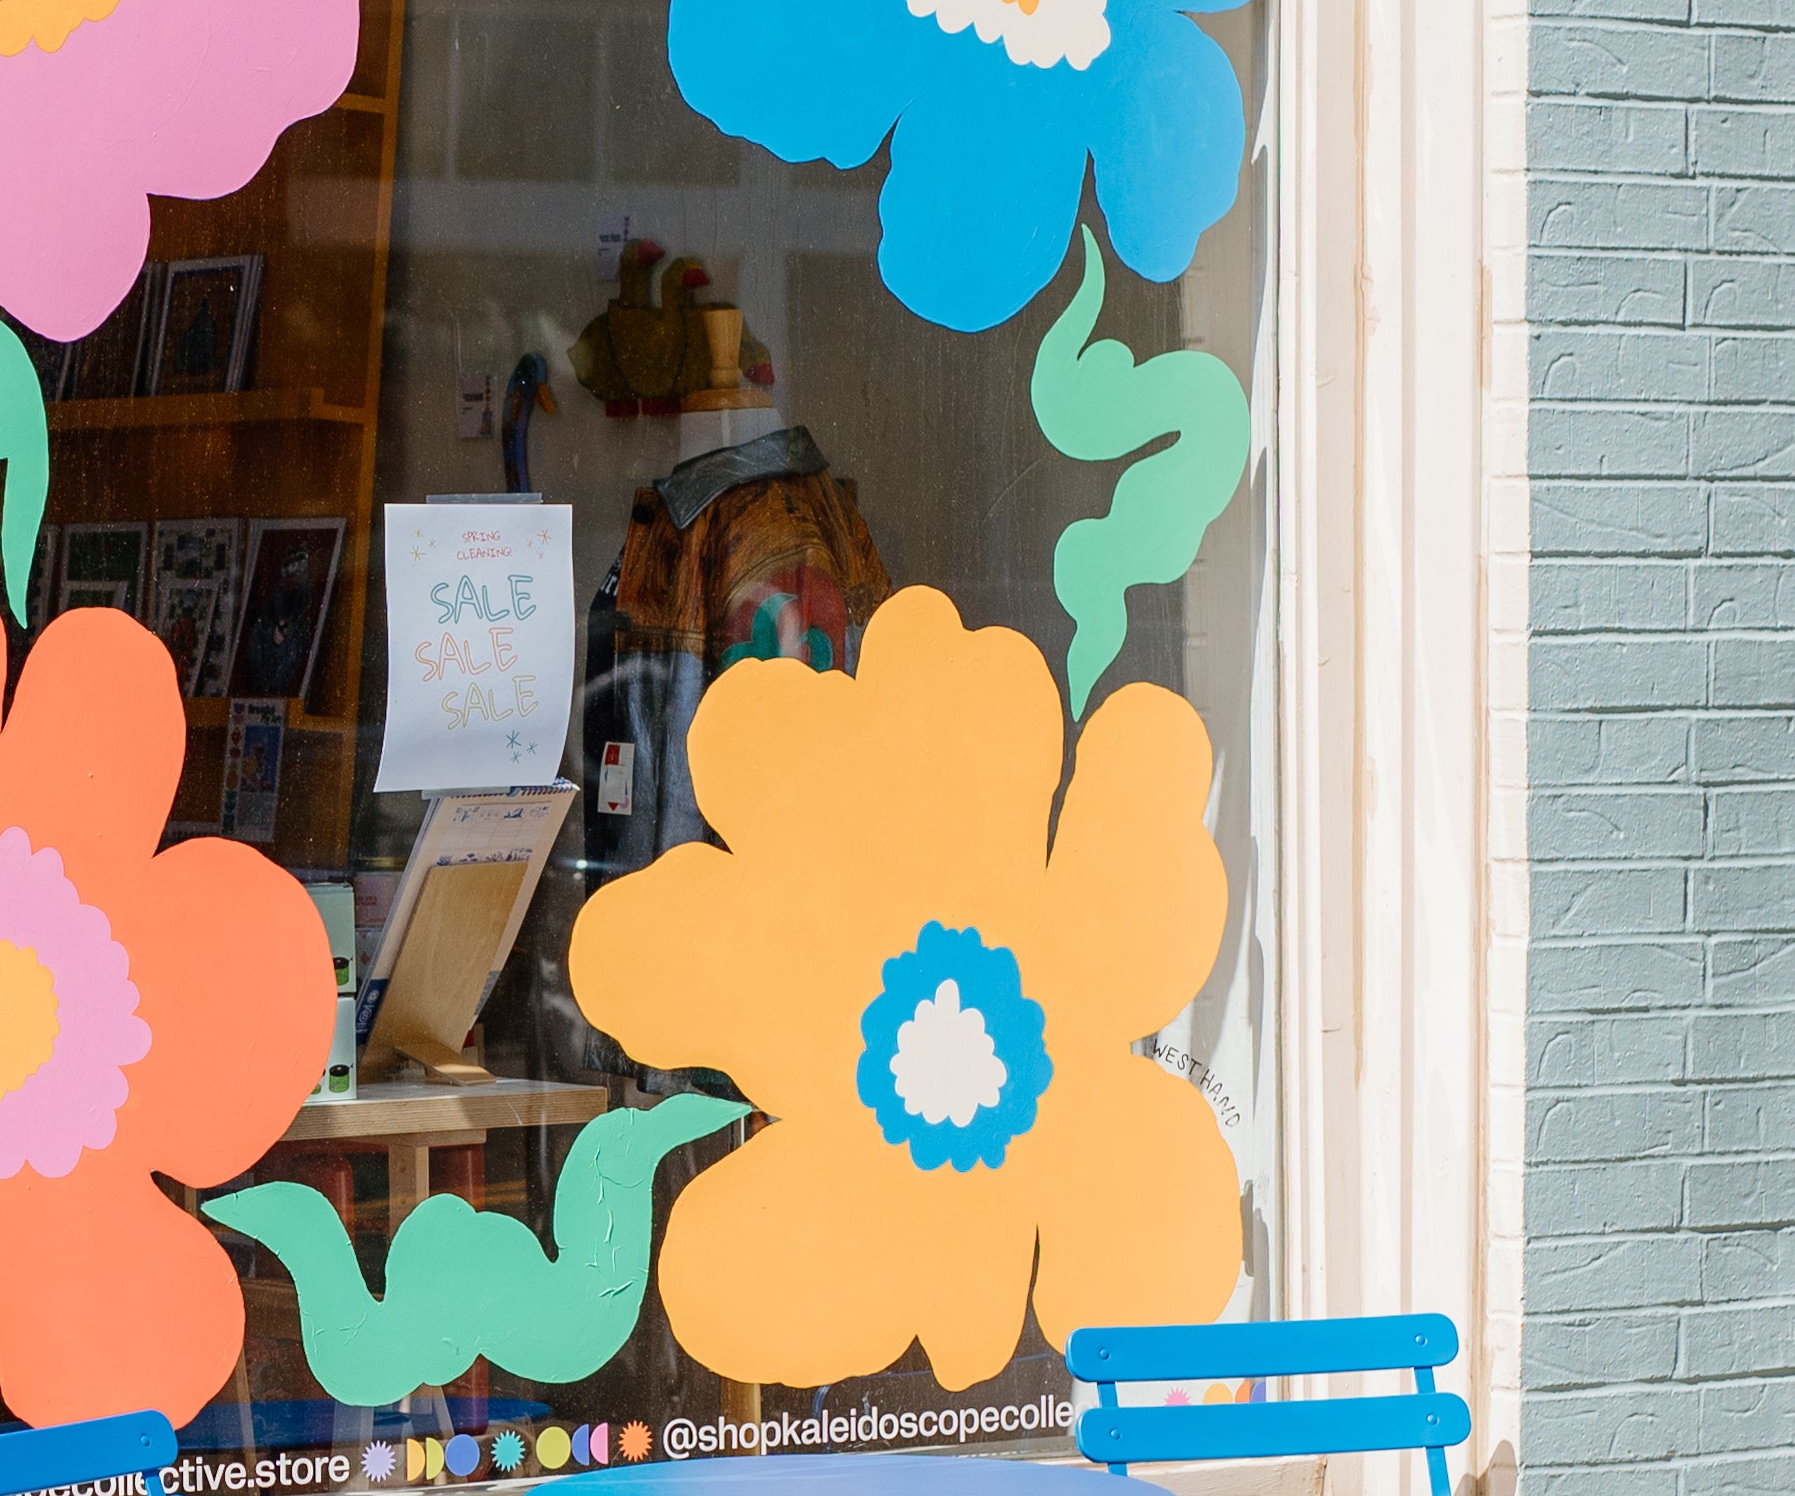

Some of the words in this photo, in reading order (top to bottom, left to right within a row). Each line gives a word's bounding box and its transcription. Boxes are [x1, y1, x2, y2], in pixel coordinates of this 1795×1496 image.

[456, 546, 513, 561] CLEANING
[461, 530, 502, 544] SPRING
[430, 574, 537, 625] SALE
[414, 627, 518, 682] SALE
[441, 675, 540, 731] SALE
